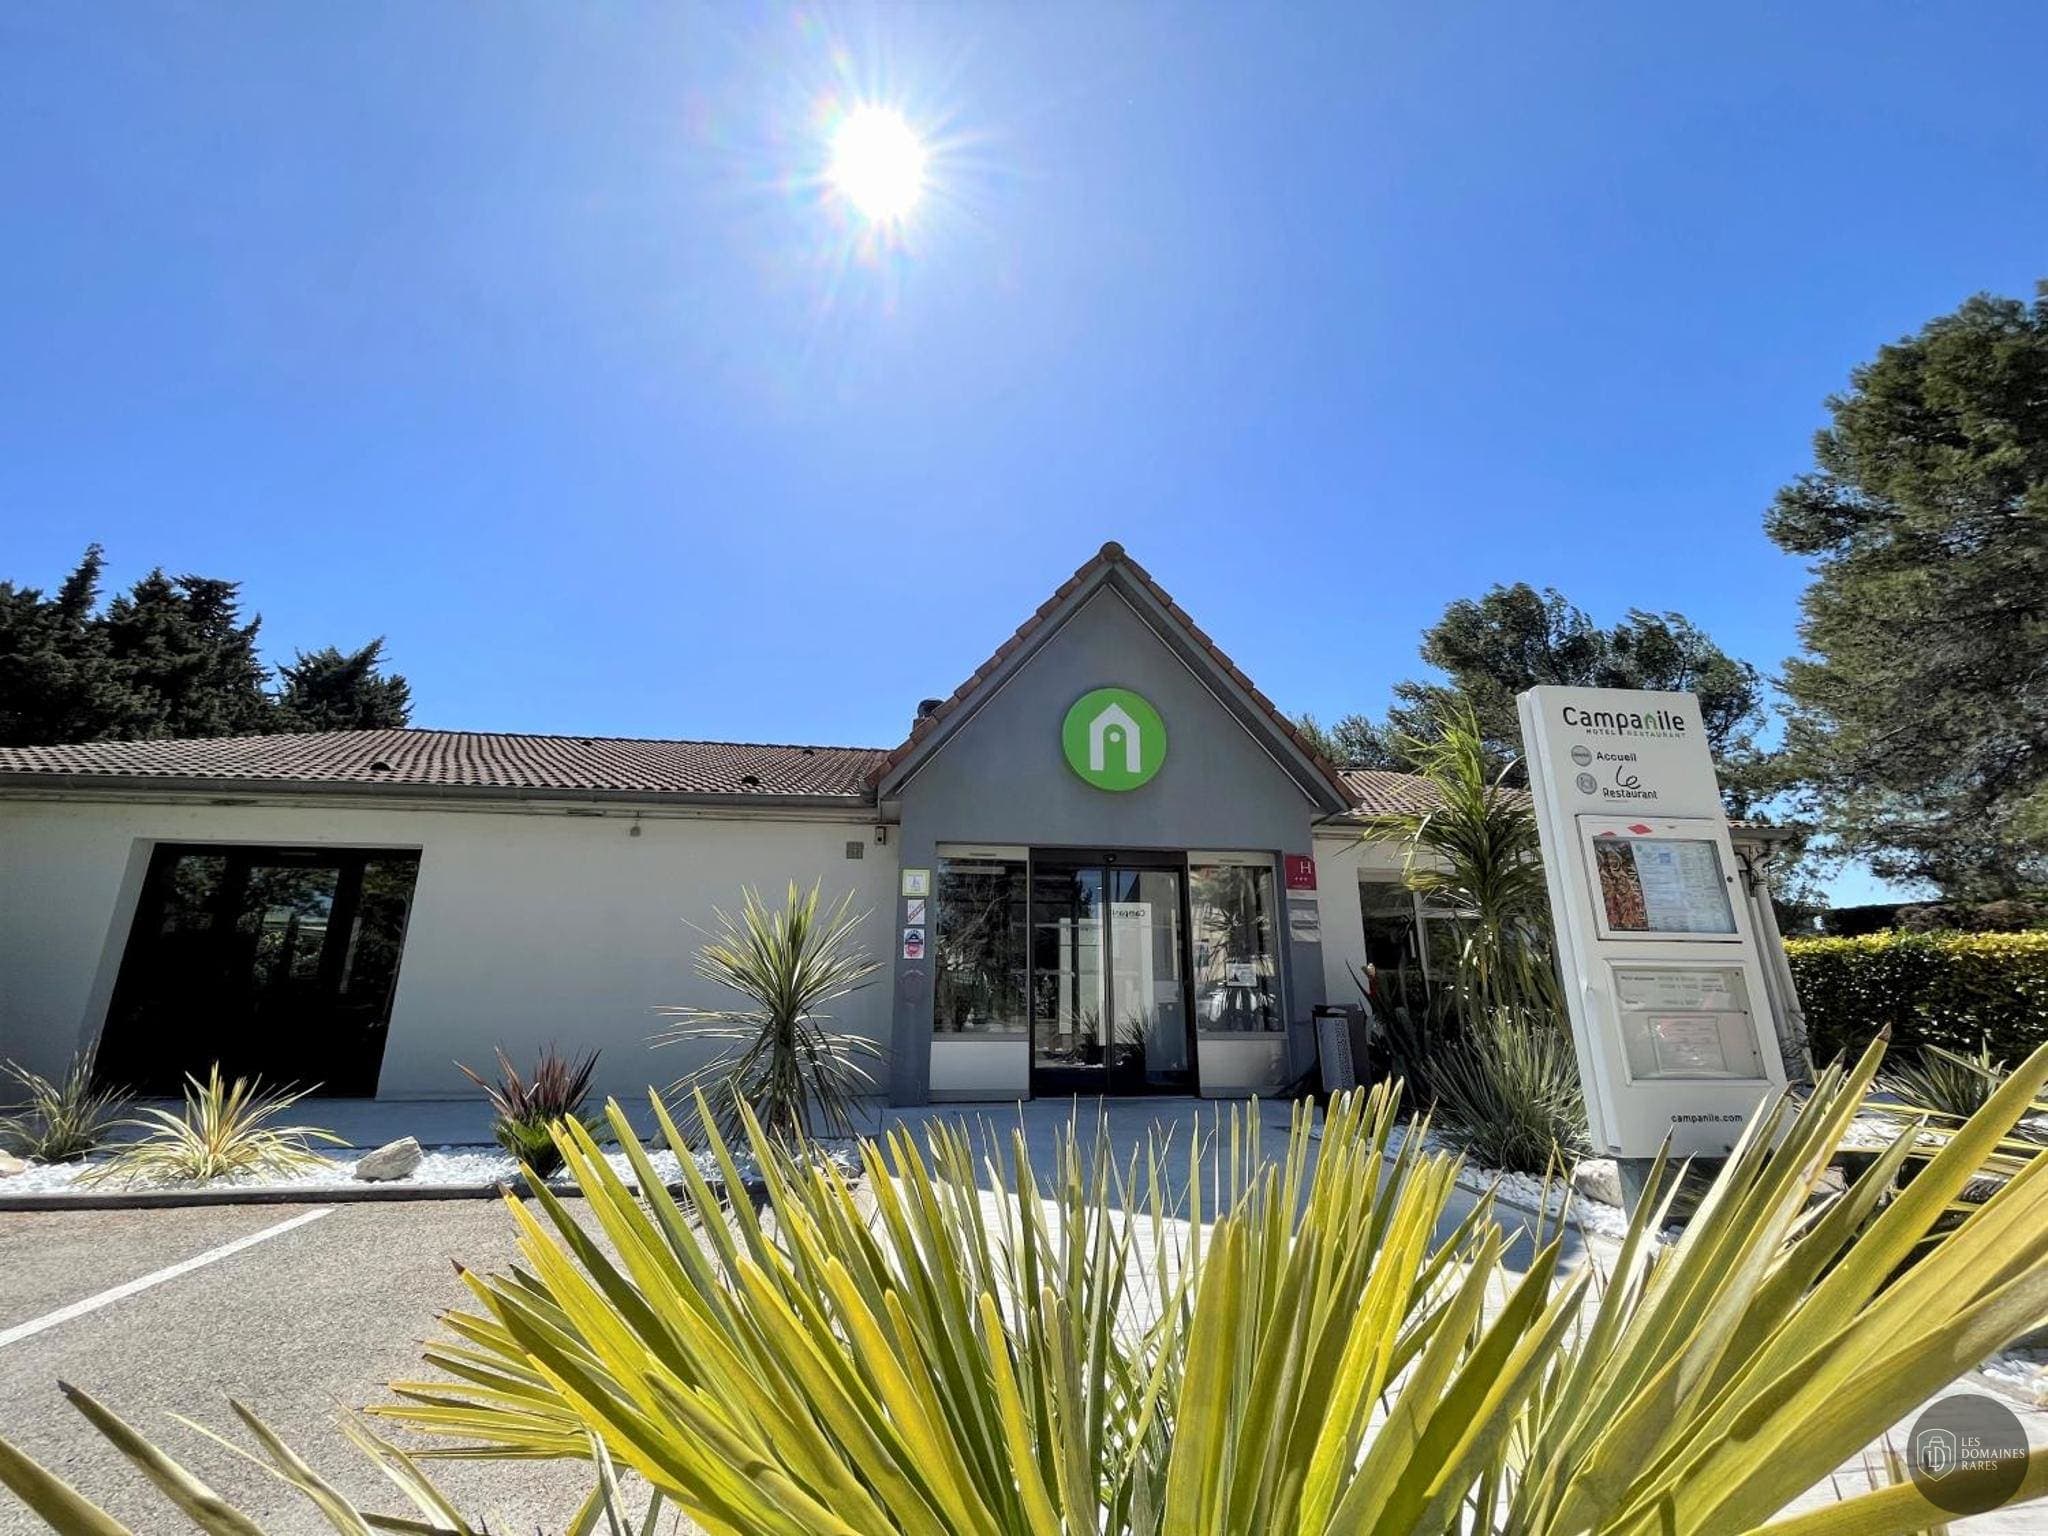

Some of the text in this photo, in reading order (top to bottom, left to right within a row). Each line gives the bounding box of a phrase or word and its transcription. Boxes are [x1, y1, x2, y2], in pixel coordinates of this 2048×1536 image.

[1562, 706, 1686, 735] Campanile
[1596, 751, 1637, 762] Accueil
[1602, 787, 1658, 800] Restaurant
[1300, 860, 1312, 875] H
[1670, 1113, 1743, 1123] campanile.com
